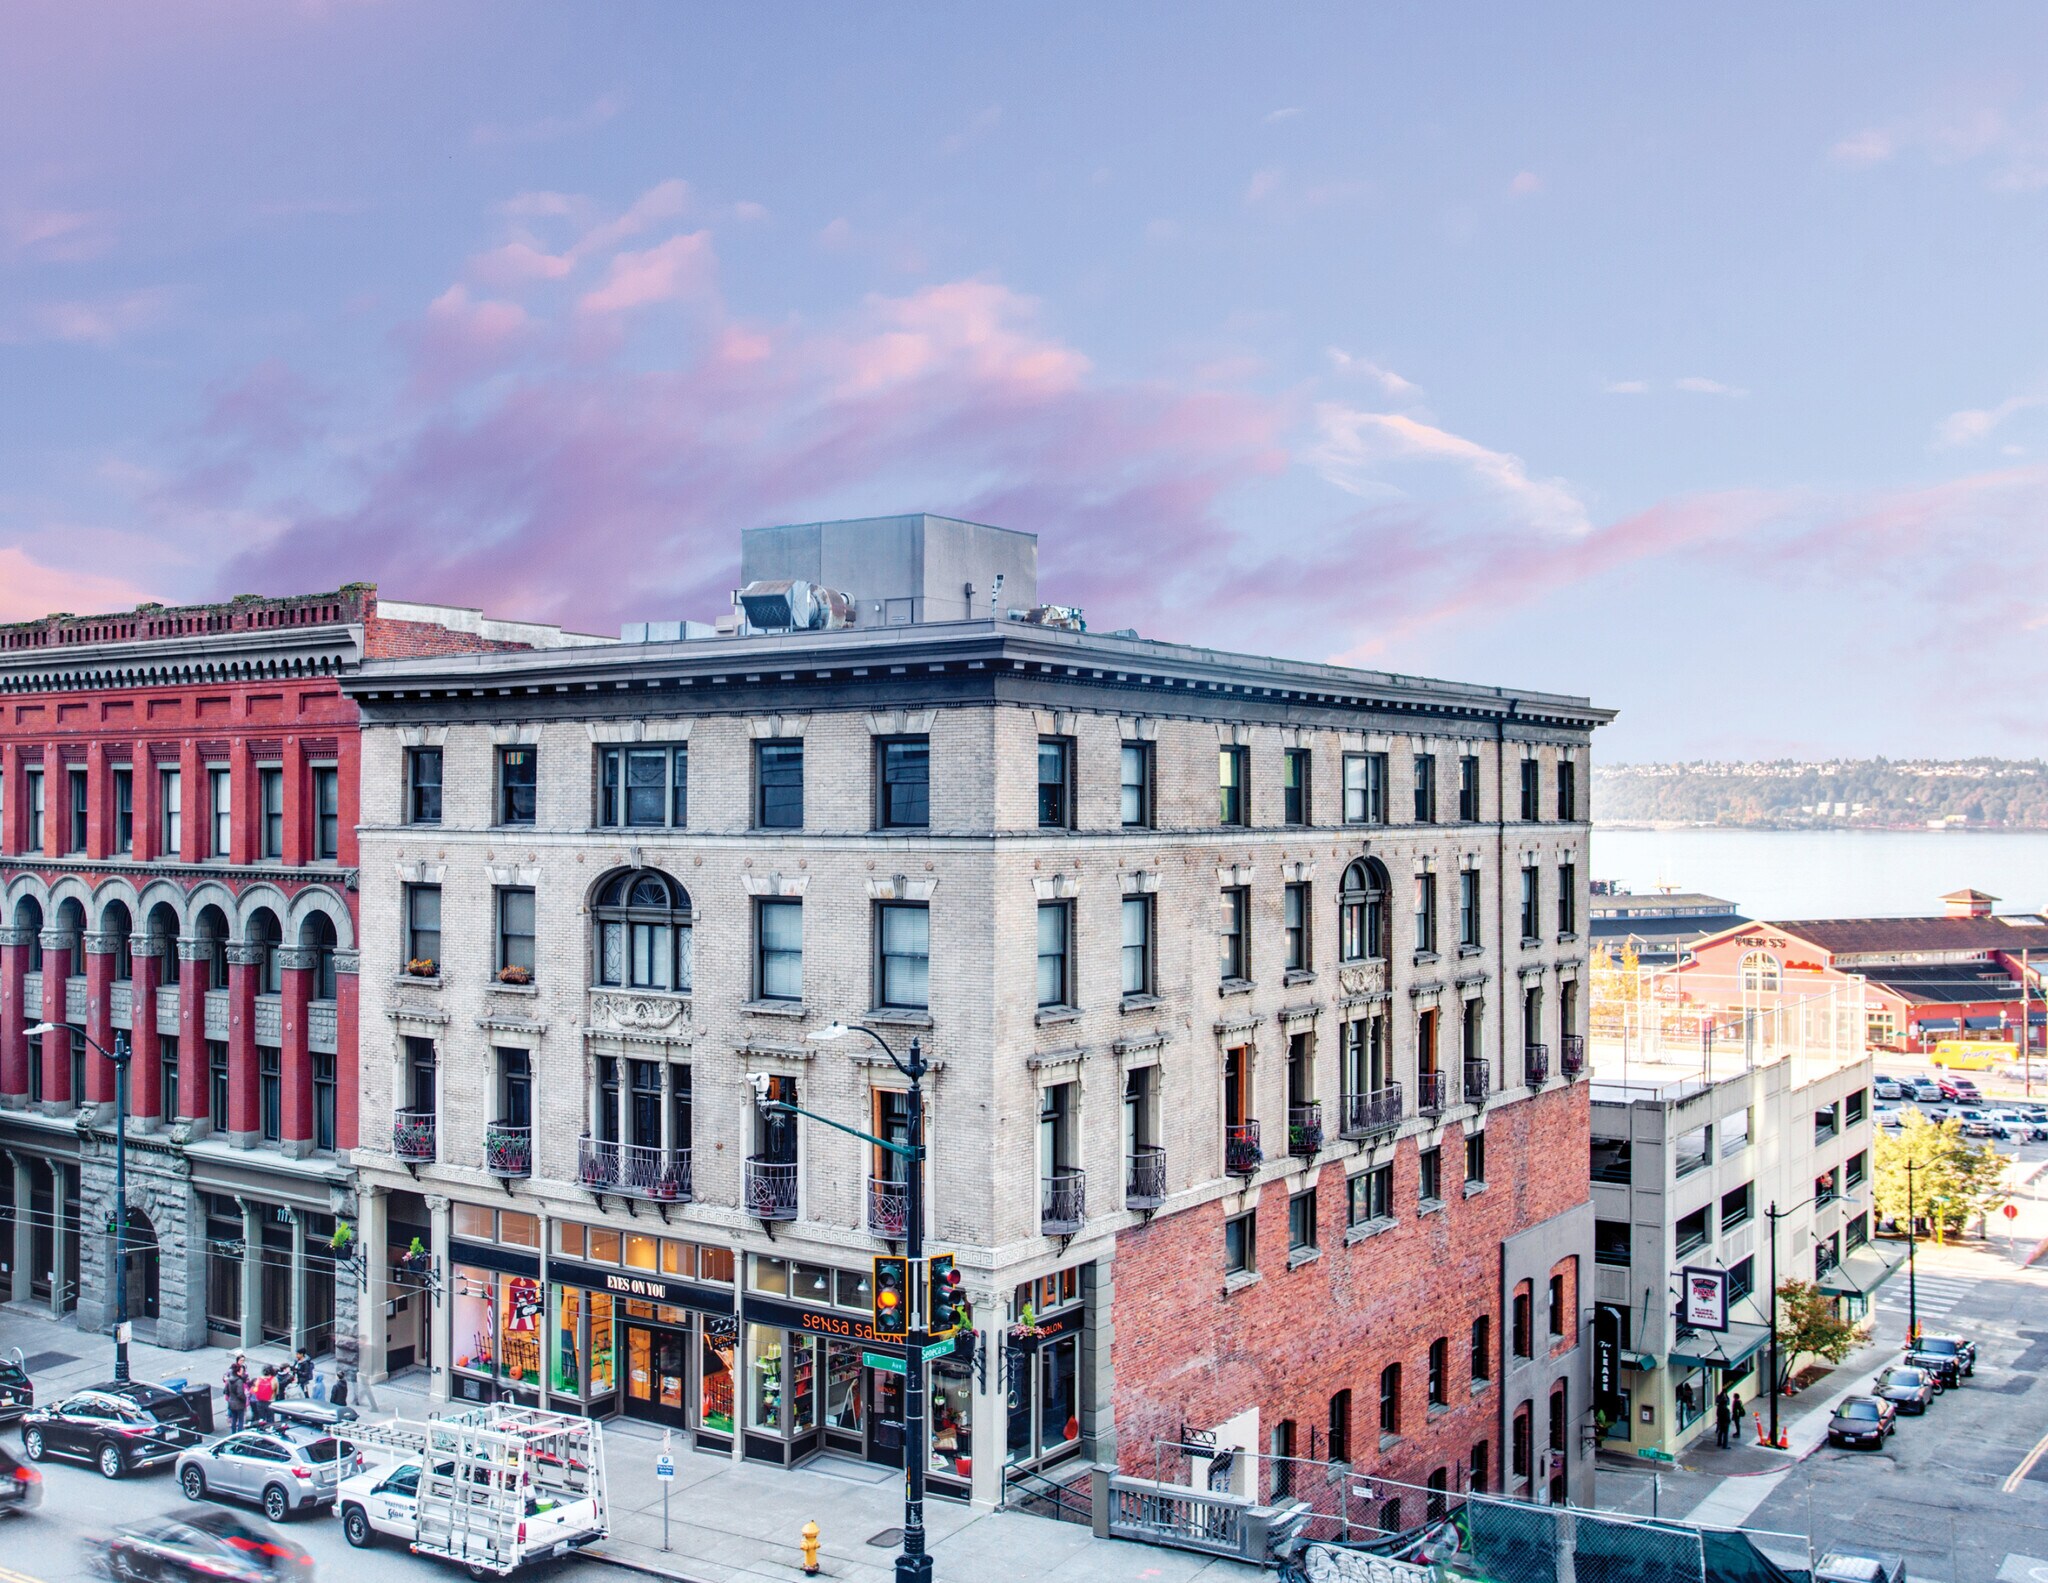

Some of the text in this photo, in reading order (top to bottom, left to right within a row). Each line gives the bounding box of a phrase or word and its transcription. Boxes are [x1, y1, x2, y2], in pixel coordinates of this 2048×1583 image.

[1735, 936, 1766, 947] PIER
[607, 1275, 666, 1298] EYES ON YOU
[1693, 1287, 1716, 1297] PIZZA
[922, 1346, 941, 1360] Seneca
[891, 1362, 902, 1370] Ave
[1598, 1340, 1611, 1391] For LEASE
